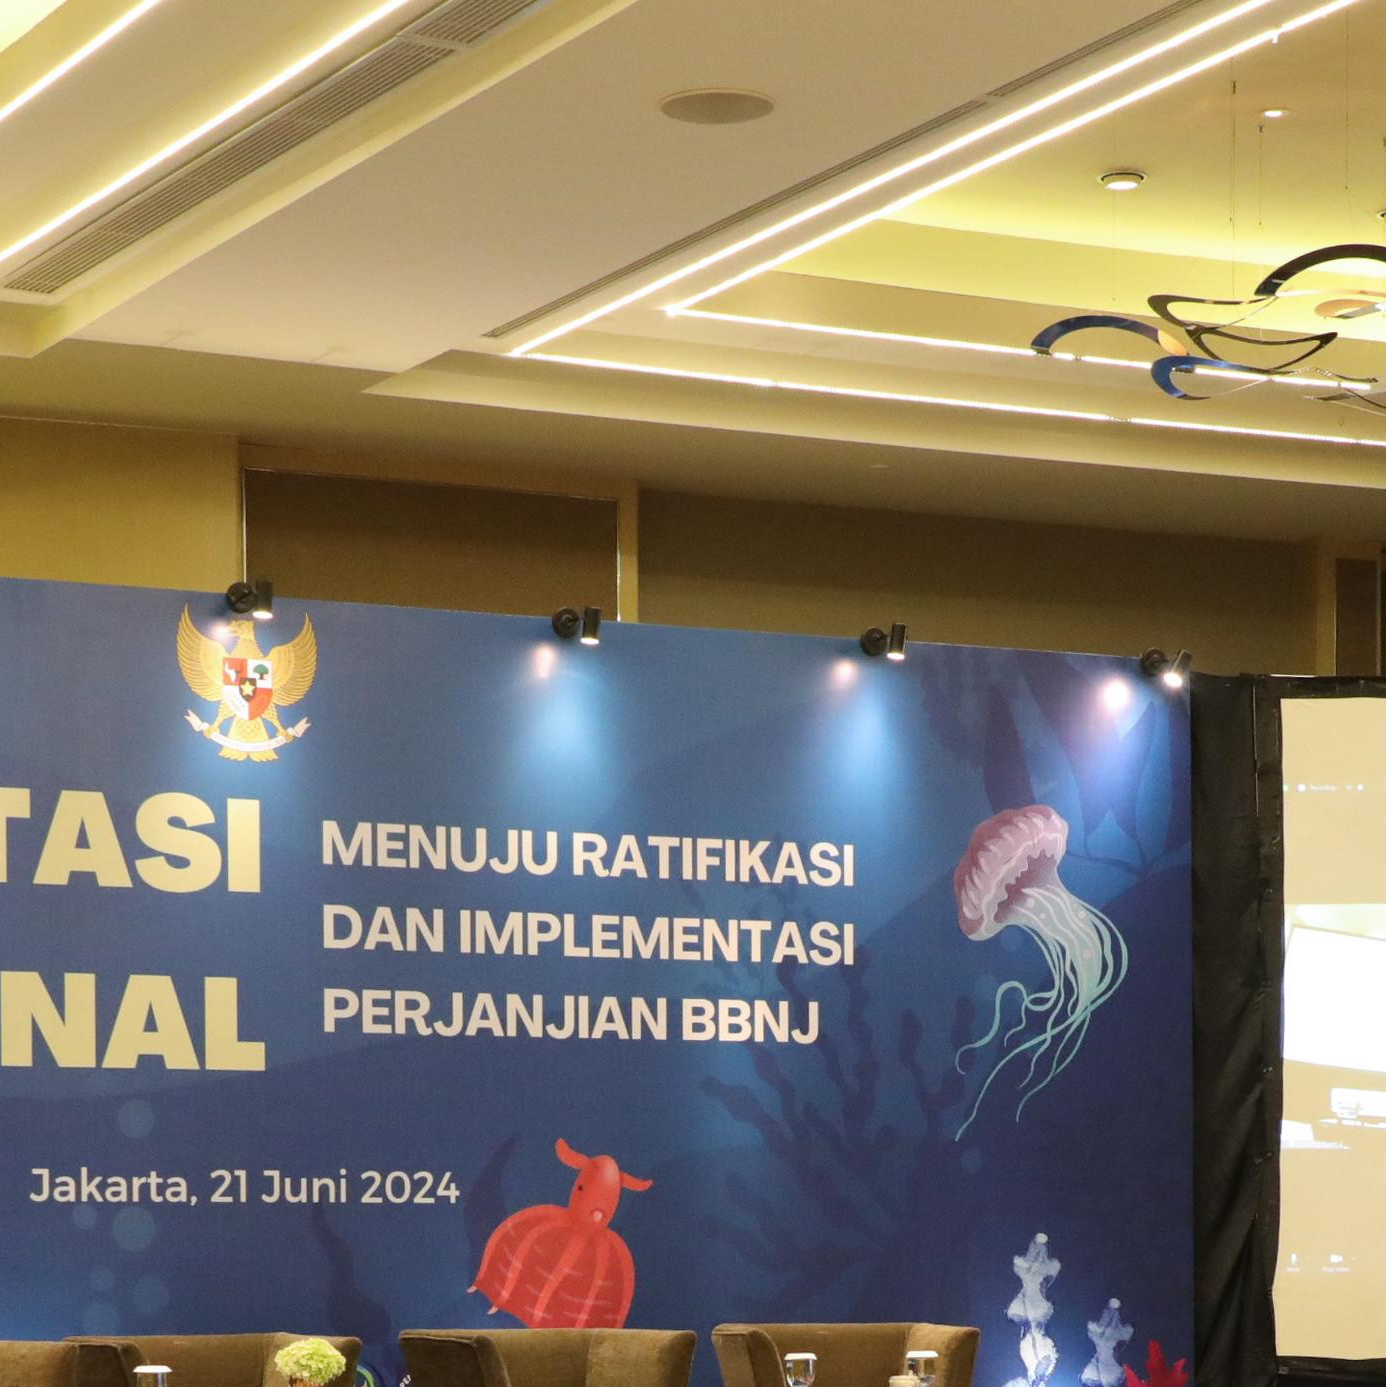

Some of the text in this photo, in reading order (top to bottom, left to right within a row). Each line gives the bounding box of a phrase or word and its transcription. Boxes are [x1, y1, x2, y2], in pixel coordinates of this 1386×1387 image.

[322, 820, 855, 887] MENUJU RATIFIKASI
[322, 905, 855, 966] DAN IMPLEMENTASI
[323, 988, 819, 1045] PERJANJIAN BBNJ
[29, 1167, 461, 1206] Jakarta, 21 Juni 2024
